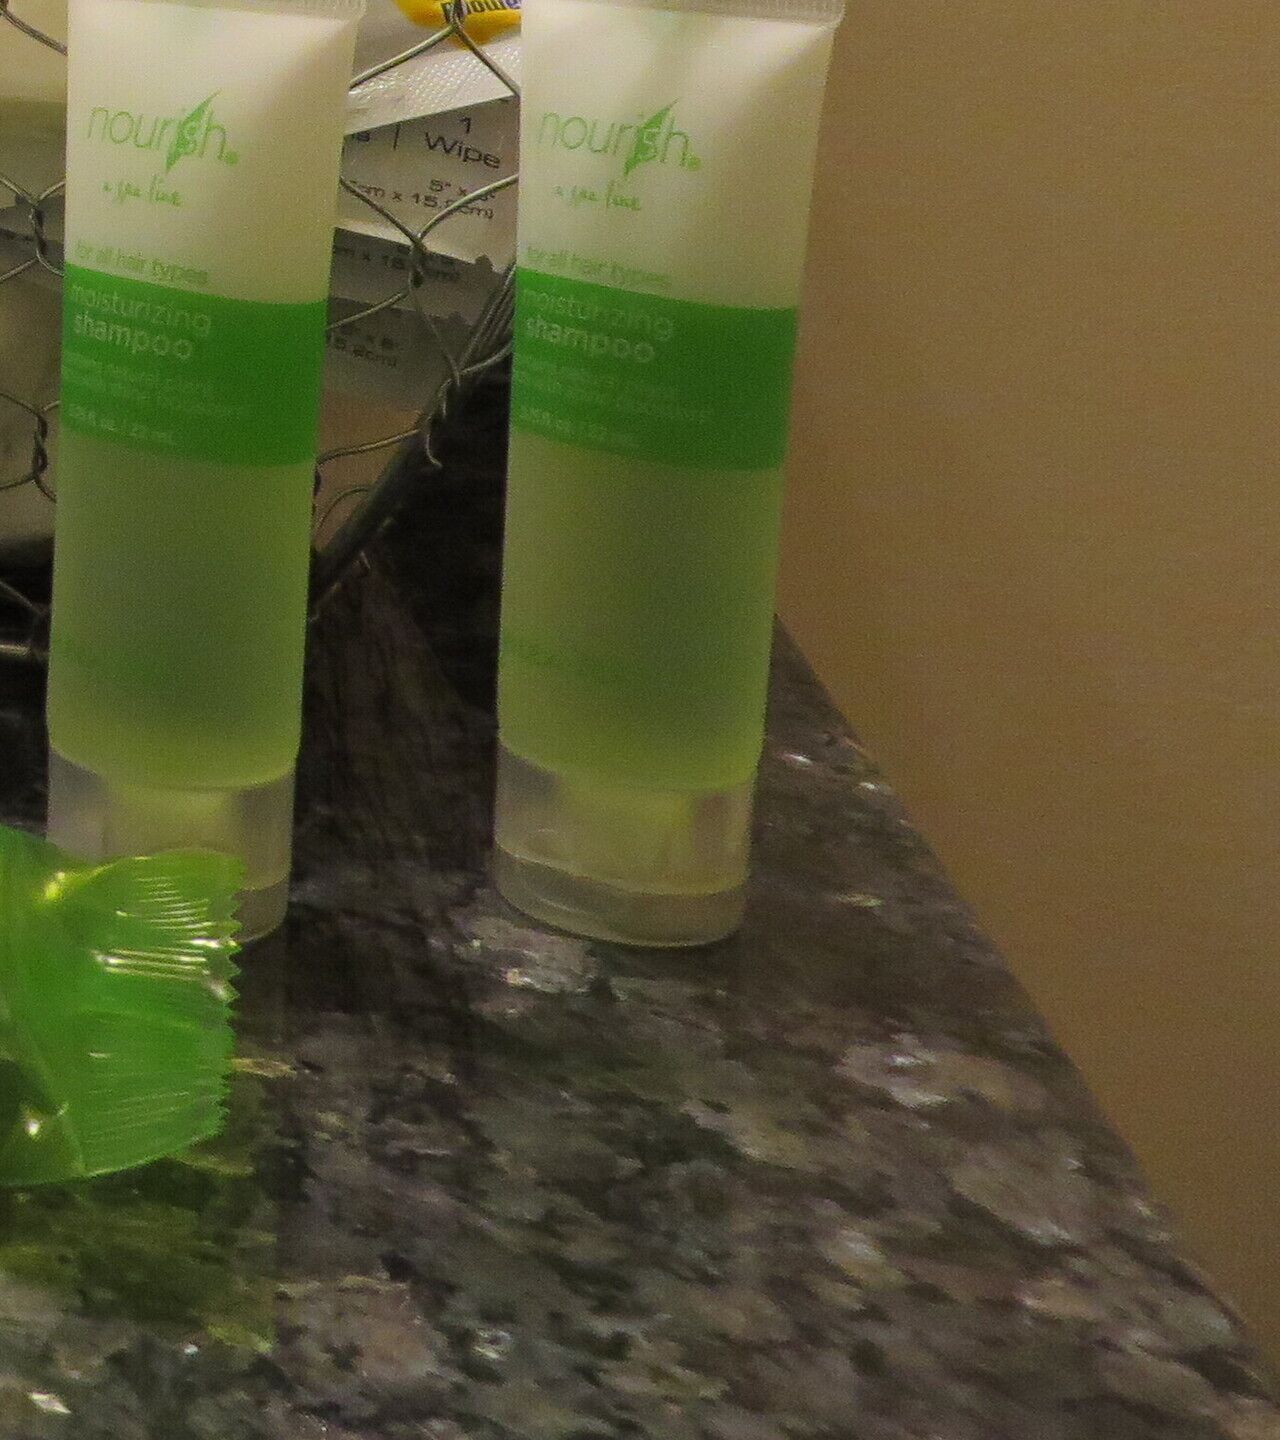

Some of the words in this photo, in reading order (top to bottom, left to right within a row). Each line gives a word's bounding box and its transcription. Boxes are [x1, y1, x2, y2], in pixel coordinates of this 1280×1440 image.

[87, 106, 228, 162] nourish
[424, 130, 501, 170] Wipe
[459, 116, 472, 135] 1
[538, 111, 690, 168] nourish
[70, 283, 213, 338] moisturizing
[74, 310, 194, 362] shampoo
[526, 314, 656, 365] shampoo
